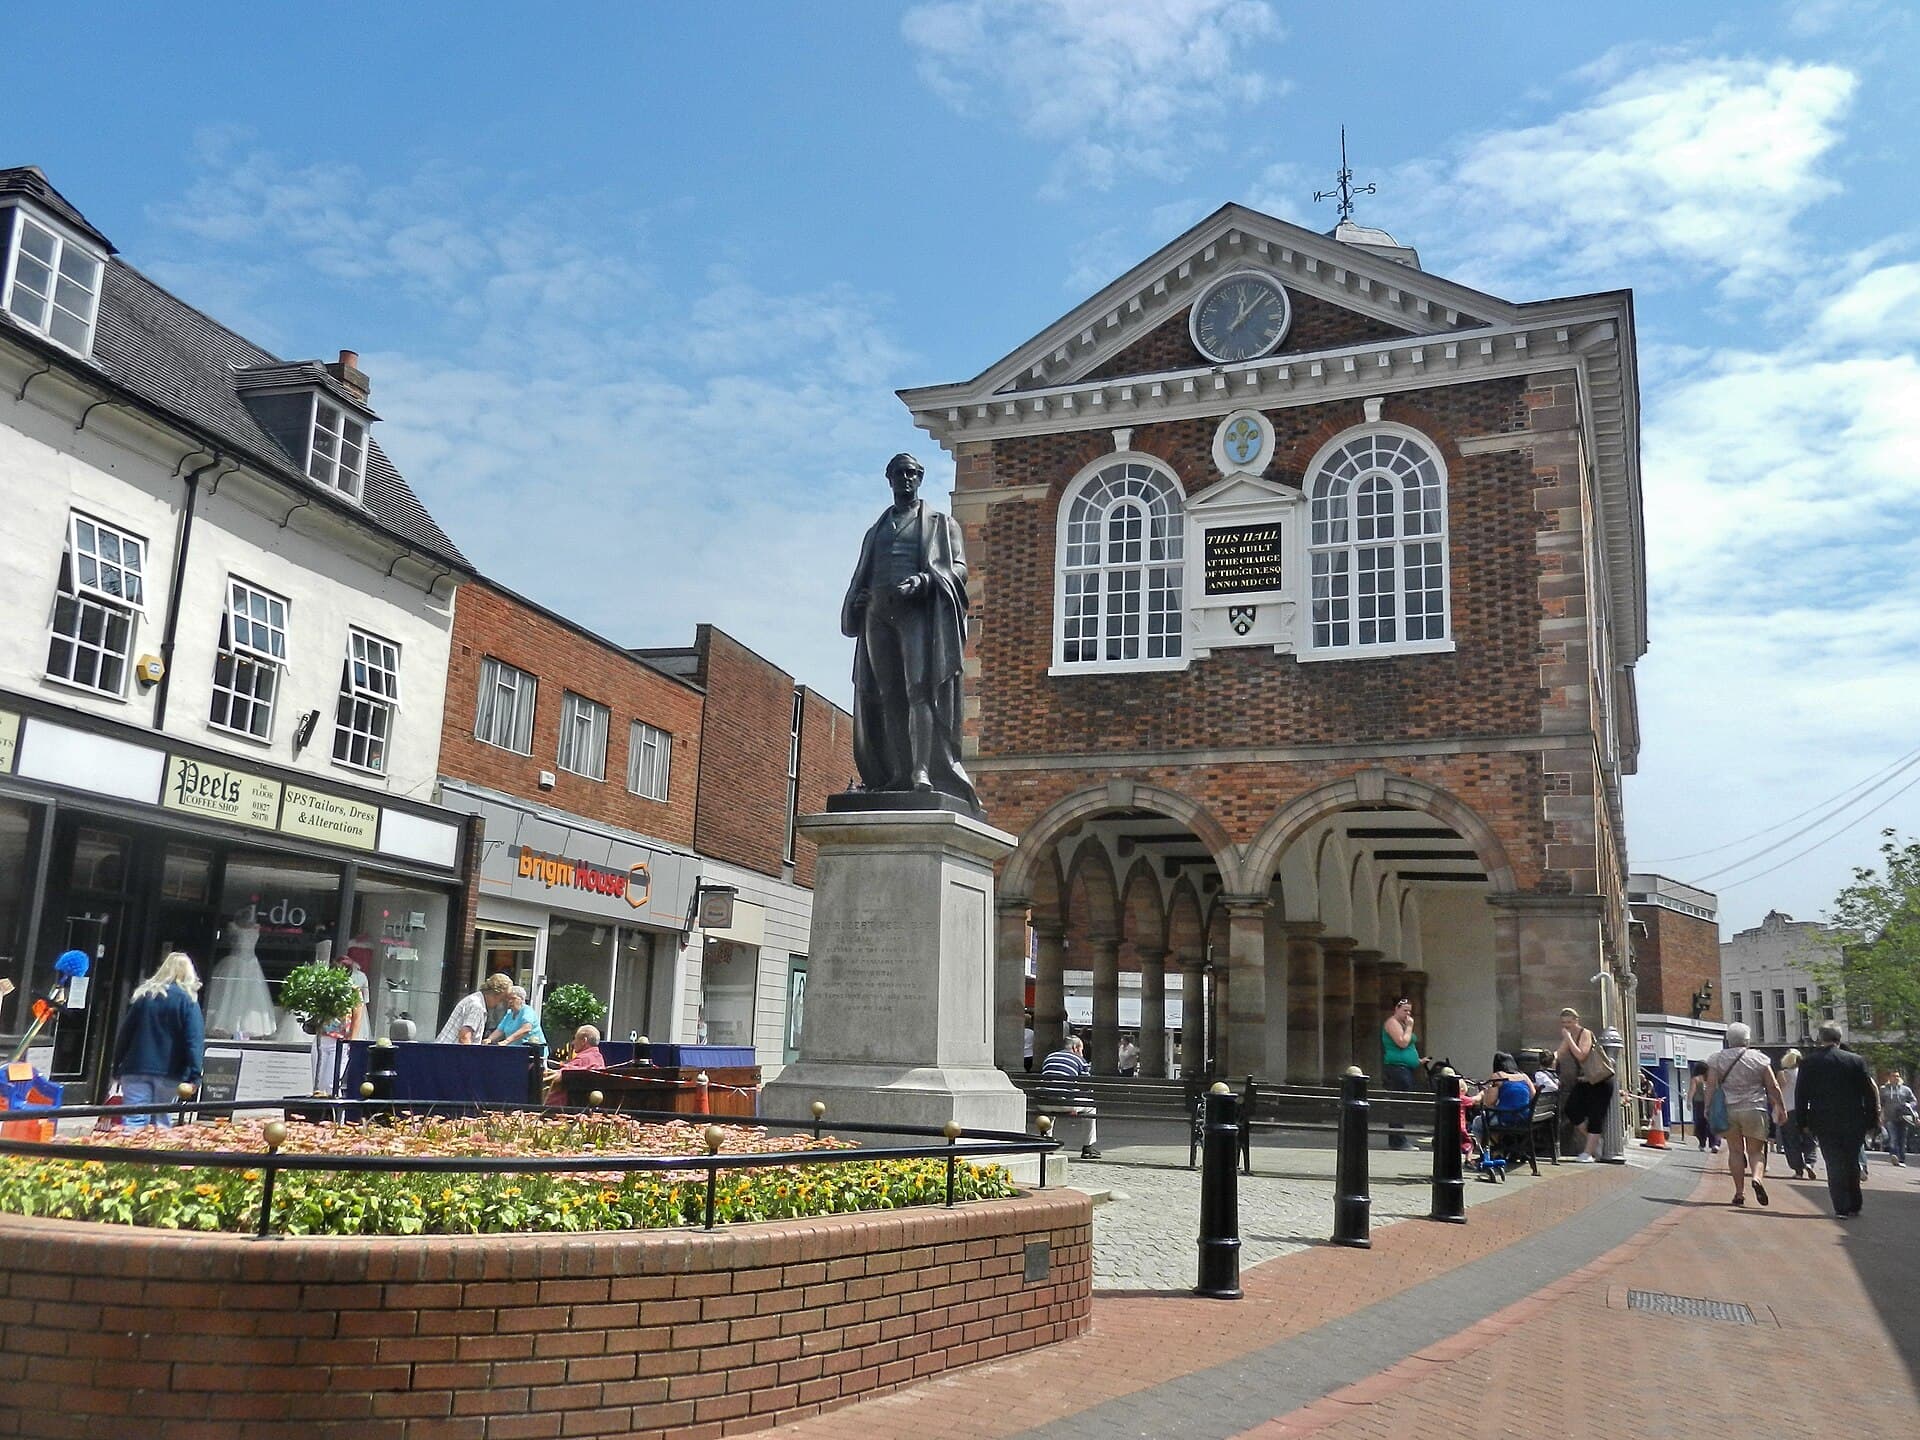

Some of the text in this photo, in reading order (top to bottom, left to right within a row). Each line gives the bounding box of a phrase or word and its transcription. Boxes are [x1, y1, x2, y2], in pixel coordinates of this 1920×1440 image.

[1207, 530, 1278, 545] THIS HALL
[1213, 543, 1272, 555] WAS BUILT
[1206, 554, 1281, 567] AT THE CHARGE
[1208, 580, 1238, 589] ANNO
[252, 788, 274, 799] FLOOR
[186, 795, 239, 814] COFFEE SHOP
[349, 806, 376, 822] Dress
[307, 814, 363, 836] Alterations
[245, 894, 307, 926] i-do
